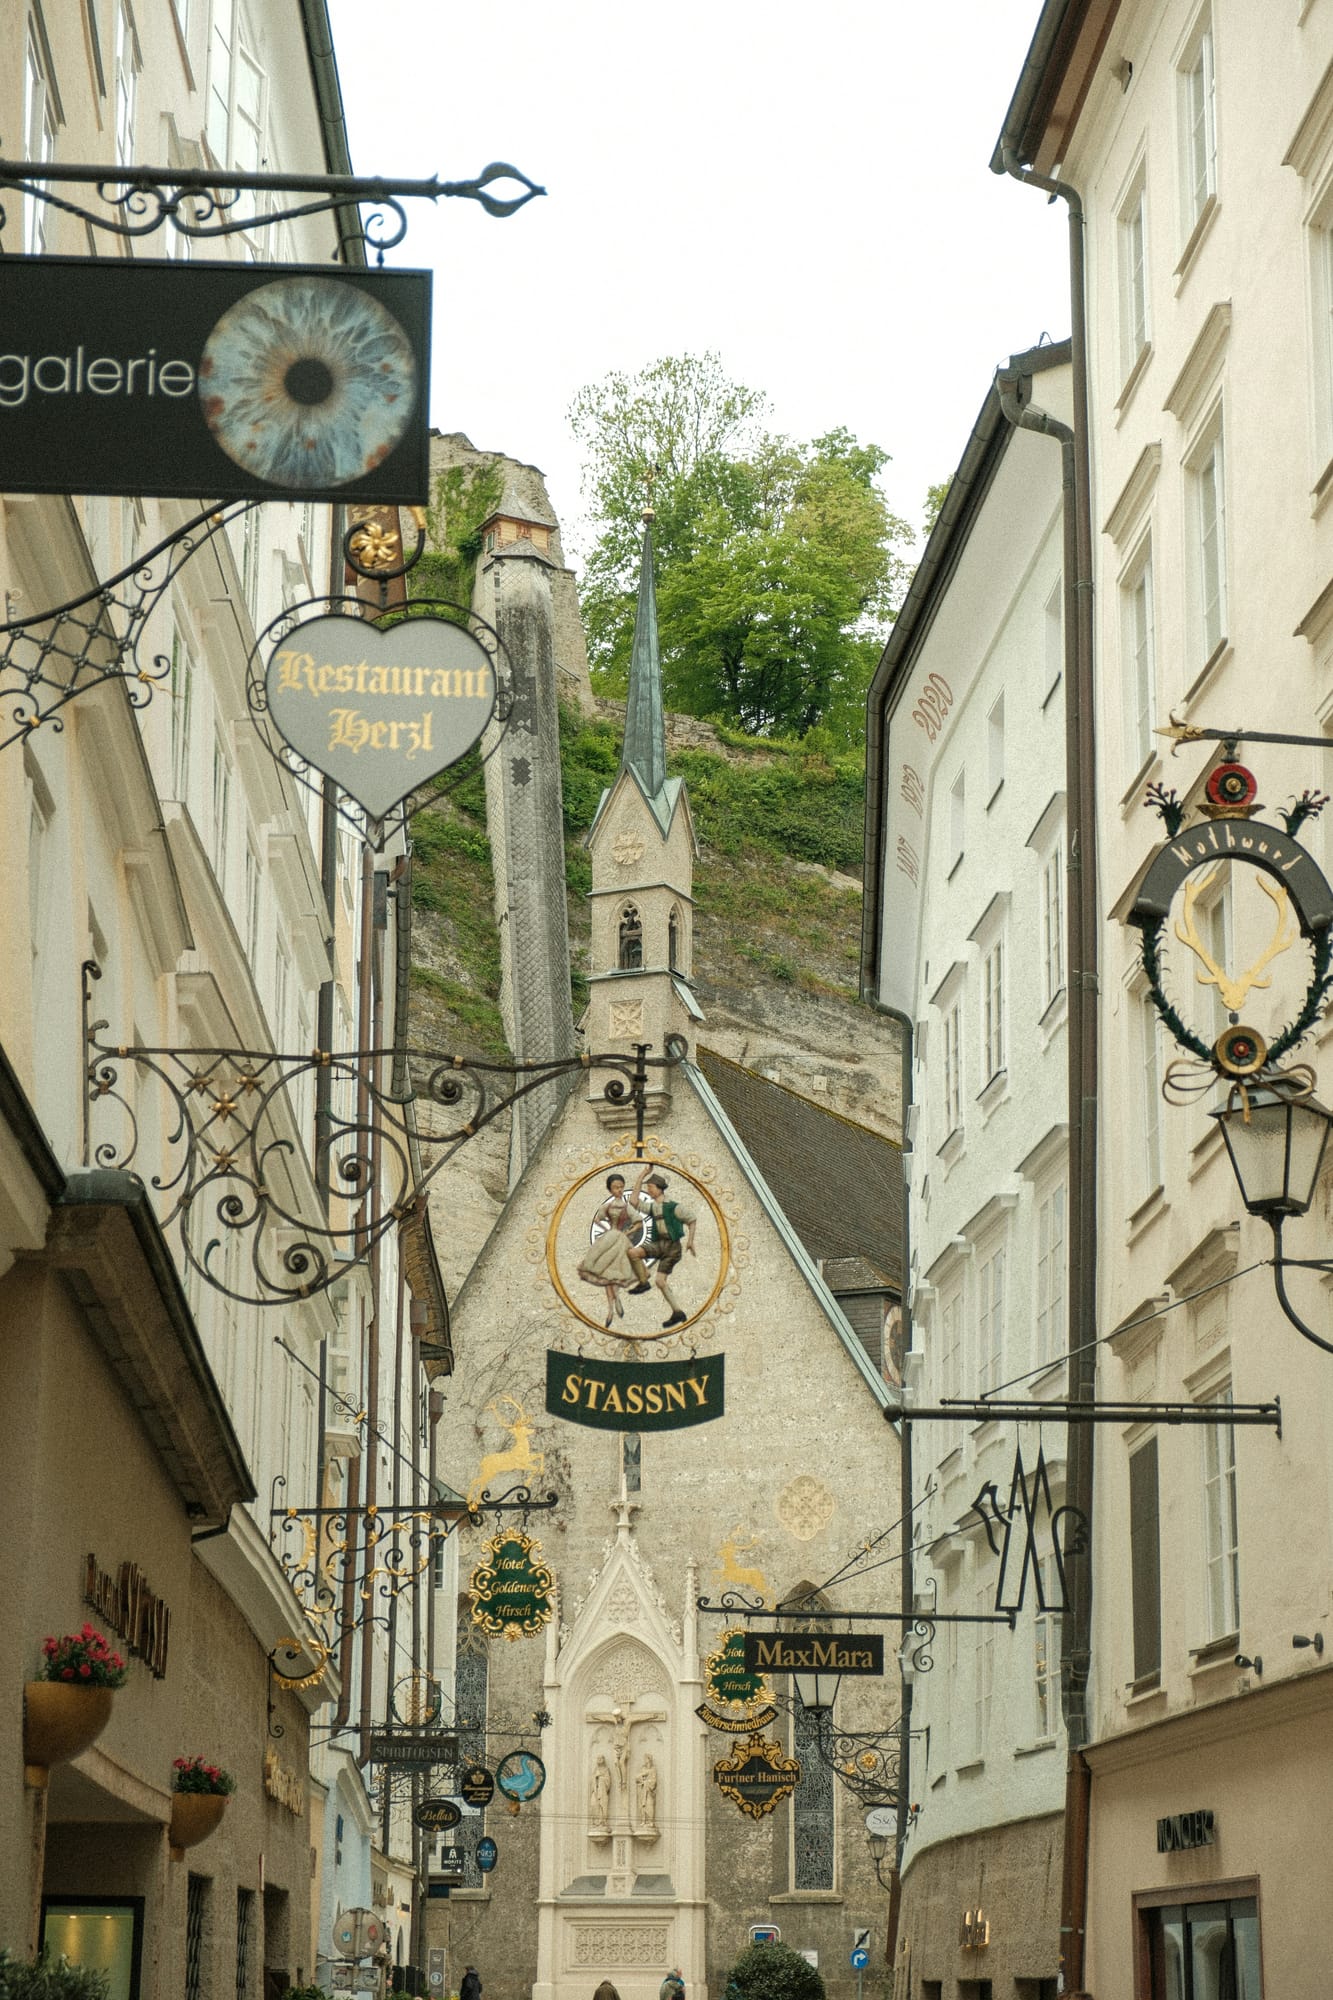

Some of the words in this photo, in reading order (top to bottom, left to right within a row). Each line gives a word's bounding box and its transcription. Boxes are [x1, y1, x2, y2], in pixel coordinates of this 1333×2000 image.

[0, 345, 195, 406] galerie
[275, 650, 489, 698] Restaurant
[912, 672, 953, 744] 2020
[327, 708, 434, 761] Herzl
[561, 1373, 711, 1415] STASSNY
[495, 1557, 527, 1570] Hotel
[490, 1581, 538, 1595] Goldener
[495, 1604, 531, 1617] Hirsch
[755, 1639, 873, 1668] MaxMara
[722, 1681, 752, 1691] Hirsch
[718, 1773, 755, 1783] Furtner
[758, 1772, 796, 1782] Hanisch
